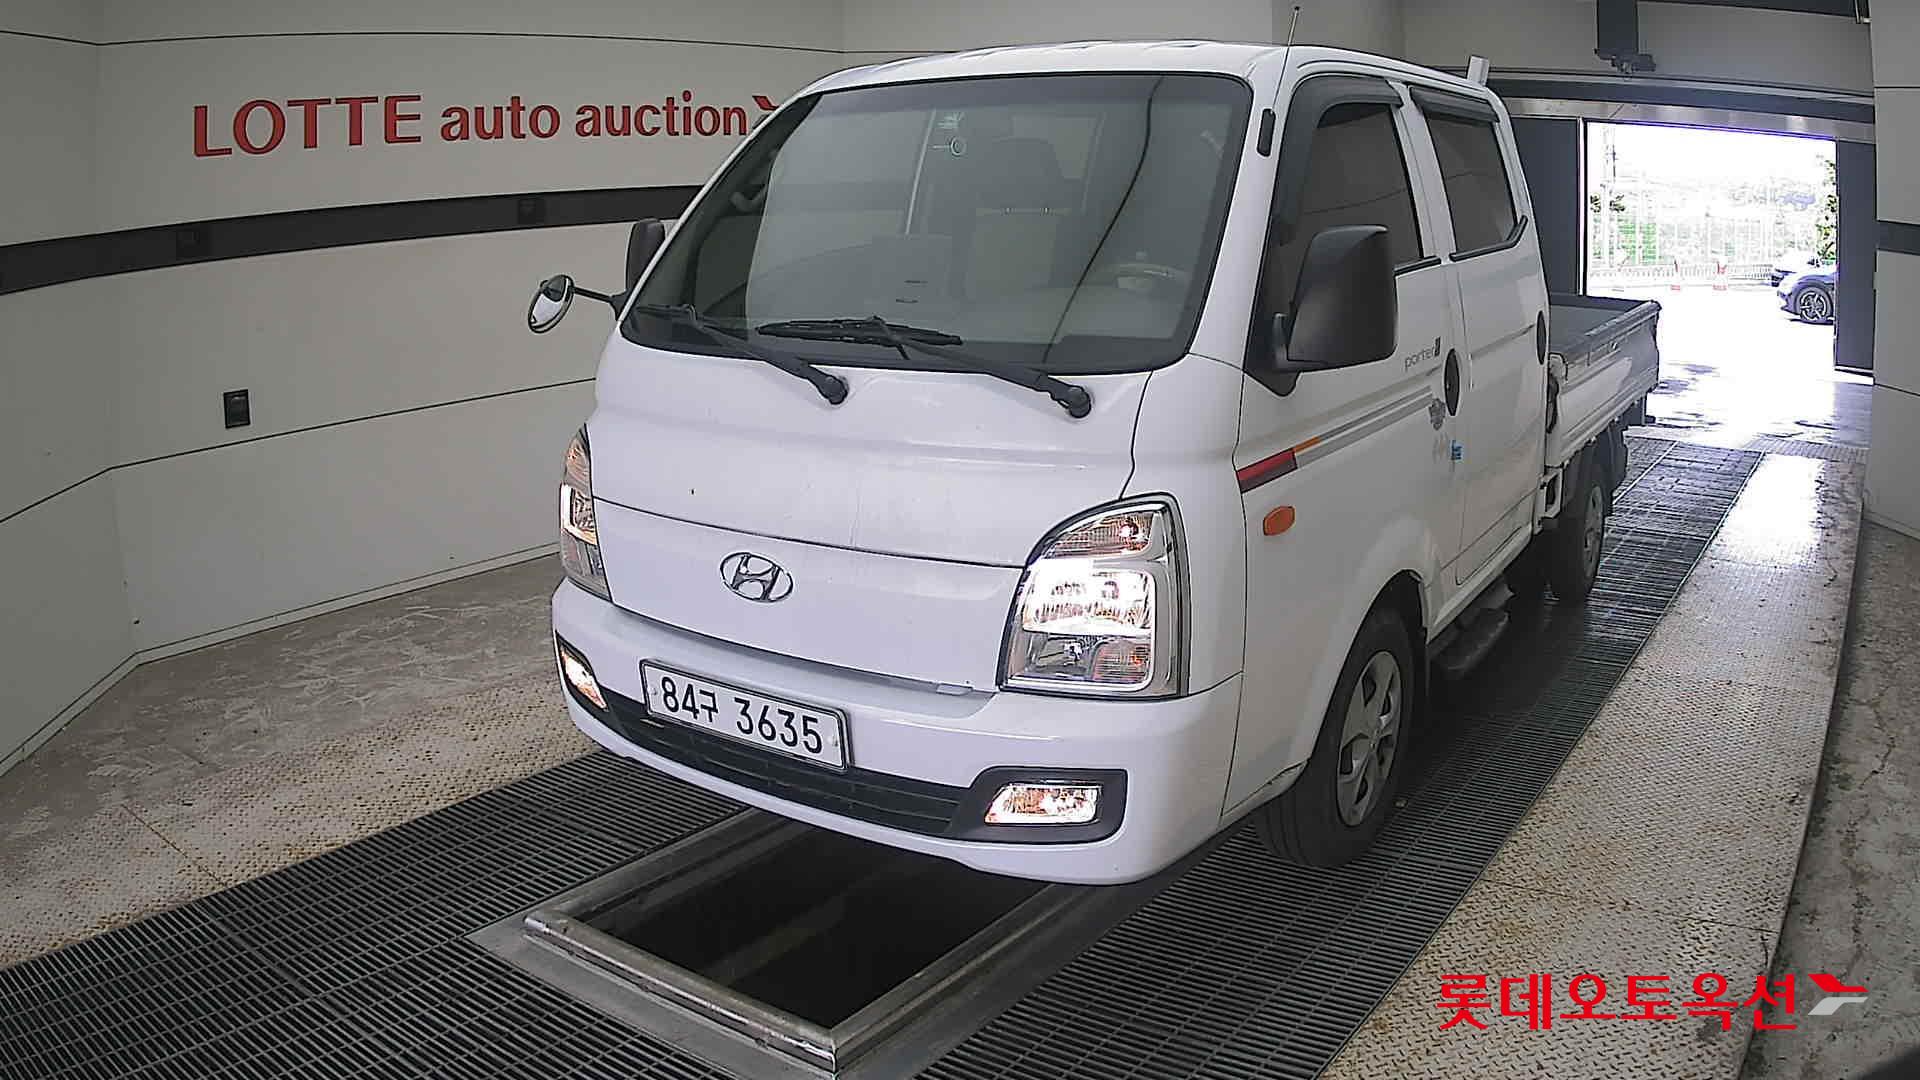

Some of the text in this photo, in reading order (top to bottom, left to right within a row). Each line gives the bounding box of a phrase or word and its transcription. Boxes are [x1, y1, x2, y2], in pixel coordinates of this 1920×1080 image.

[193, 90, 748, 158] LOTTE auto auction
[661, 676, 823, 754] 84구 3635
